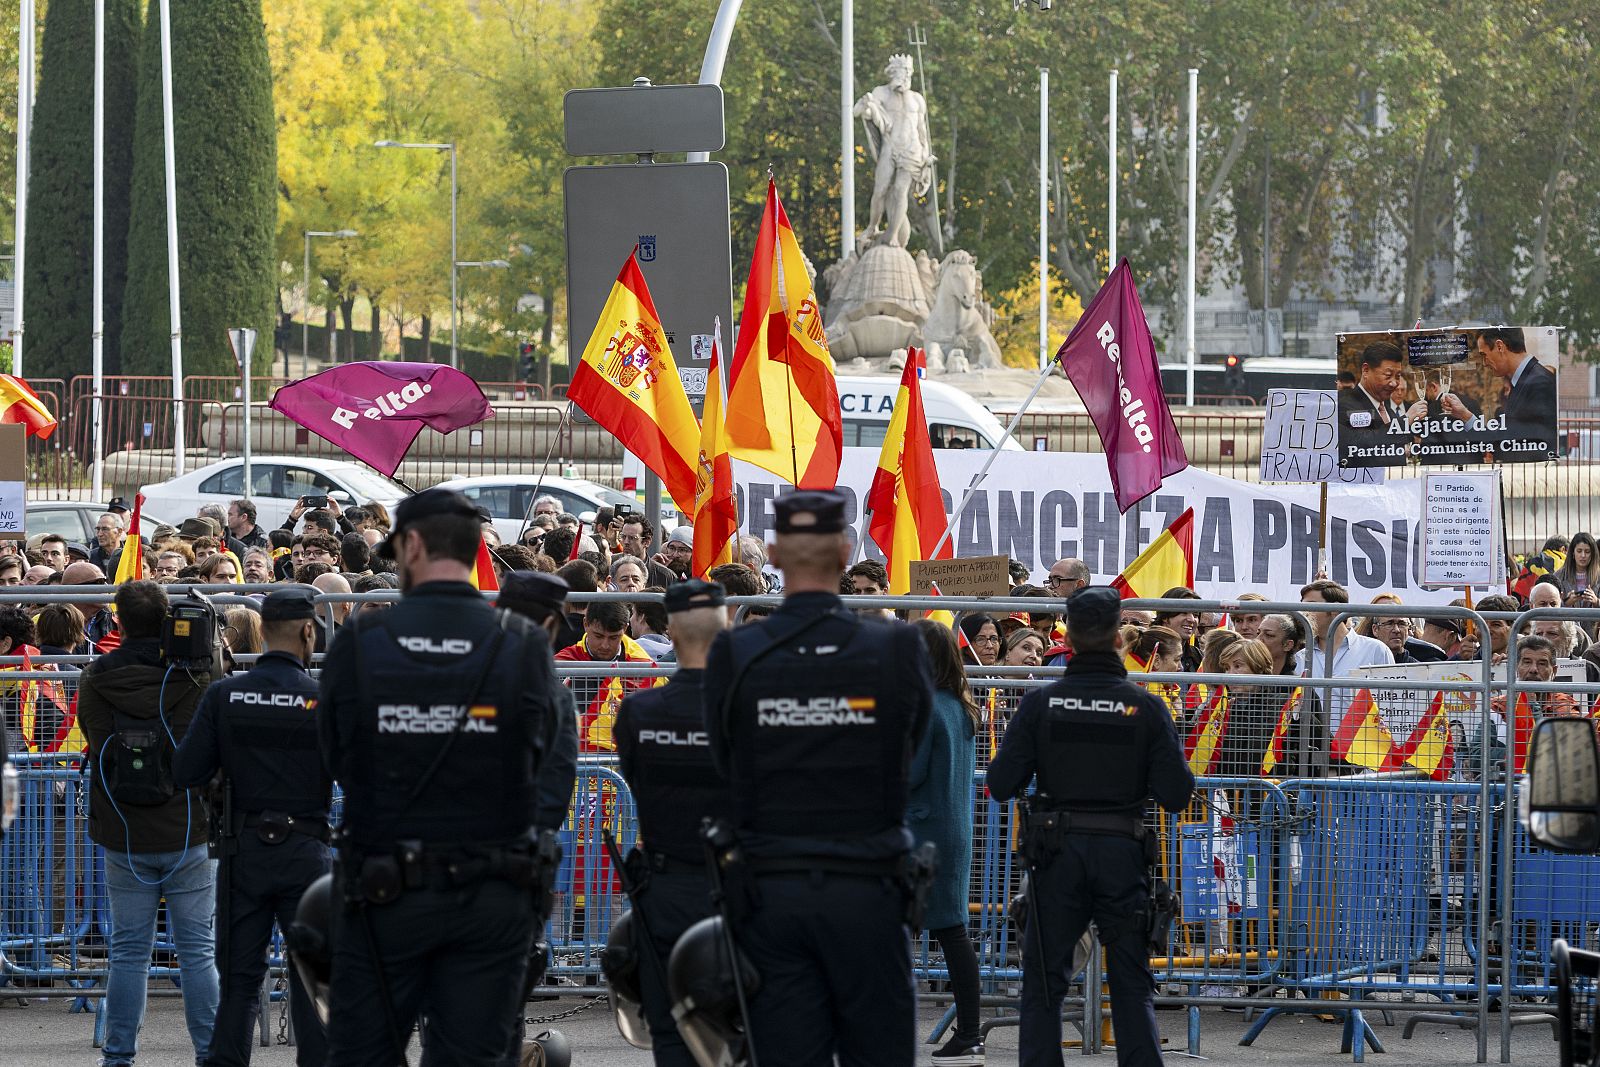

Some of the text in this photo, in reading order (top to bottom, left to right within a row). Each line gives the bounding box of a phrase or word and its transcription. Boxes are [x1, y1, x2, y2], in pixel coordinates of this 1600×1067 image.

[331, 381, 431, 430] Relta.
[840, 394, 893, 413] CIA
[1269, 392, 1336, 421] PED
[1351, 419, 1370, 427] ORDER
[1387, 414, 1507, 438] Aléjate del
[1266, 422, 1339, 450] JUD
[1348, 439, 1548, 458] Partido Comunista Chino
[1434, 484, 1475, 492] El Partido
[1427, 495, 1483, 503] Comunista de
[0, 521, 18, 531] ERE
[1427, 516, 1453, 524] núcleo
[1426, 527, 1440, 535] Sin
[1464, 527, 1491, 535] núcleo
[1195, 496, 1236, 582] A
[1252, 498, 1489, 592] PRISI
[1469, 538, 1481, 546] del
[968, 563, 975, 572] A
[1443, 571, 1466, 579] -Mao-
[916, 579, 931, 590] POR
[934, 574, 966, 588] HORIZO
[229, 691, 306, 708] POLICIA
[1402, 689, 1415, 699] de
[757, 697, 850, 713] POLICIA
[1048, 697, 1126, 713] POLICIA
[758, 711, 876, 727] NACIONAL
[639, 729, 709, 745] POLIC
